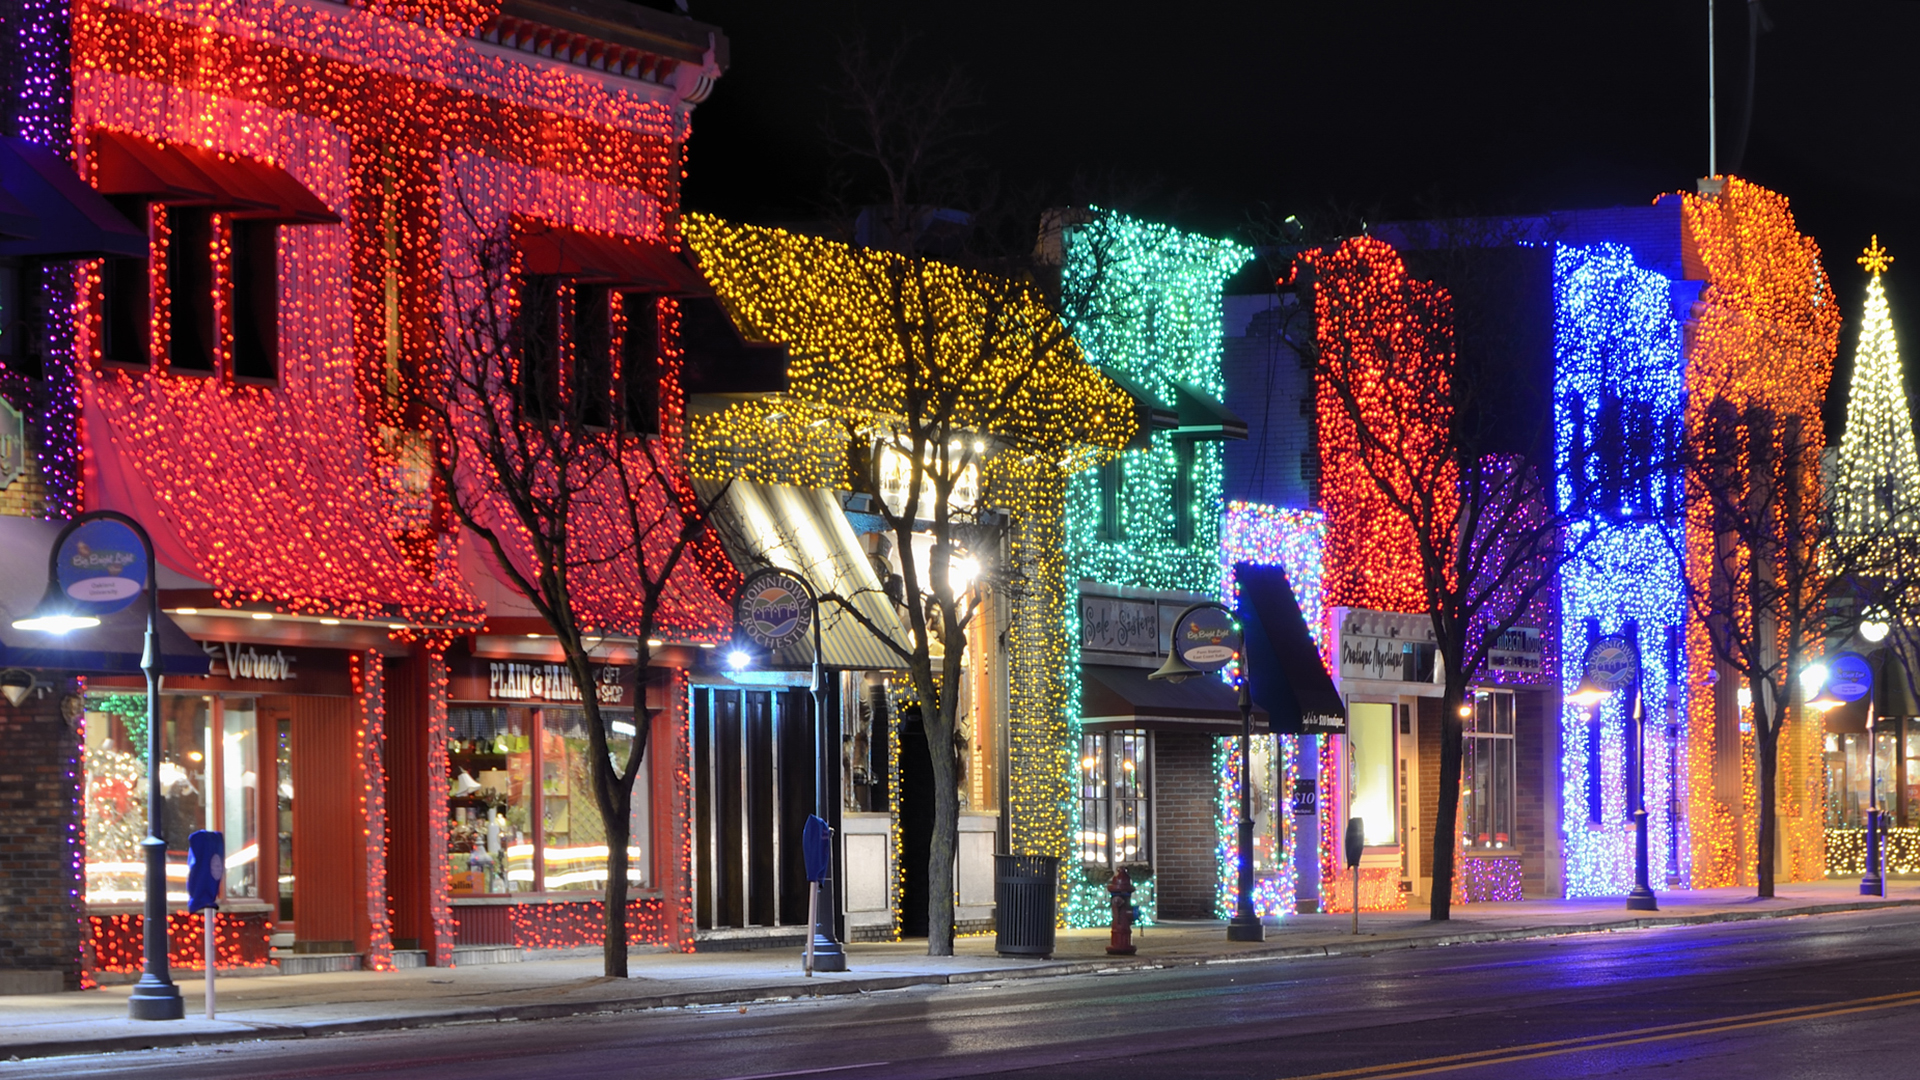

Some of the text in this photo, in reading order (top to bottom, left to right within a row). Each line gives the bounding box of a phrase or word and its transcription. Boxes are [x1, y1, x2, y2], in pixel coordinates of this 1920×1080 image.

[73, 552, 135, 569] Big Bright Light
[742, 576, 811, 611] DOWNTOWN
[742, 615, 811, 649] ROCHESTER
[1084, 606, 1156, 647] Sole Sisters
[224, 641, 290, 680] Varner
[1343, 638, 1403, 679] Boutique Angelique
[1590, 640, 1635, 665] DOWNTOWN
[490, 663, 586, 700] PLAIN & FANC
[602, 666, 620, 684] GIFT
[601, 684, 624, 703] SHOP
[1295, 792, 1315, 804] $10
